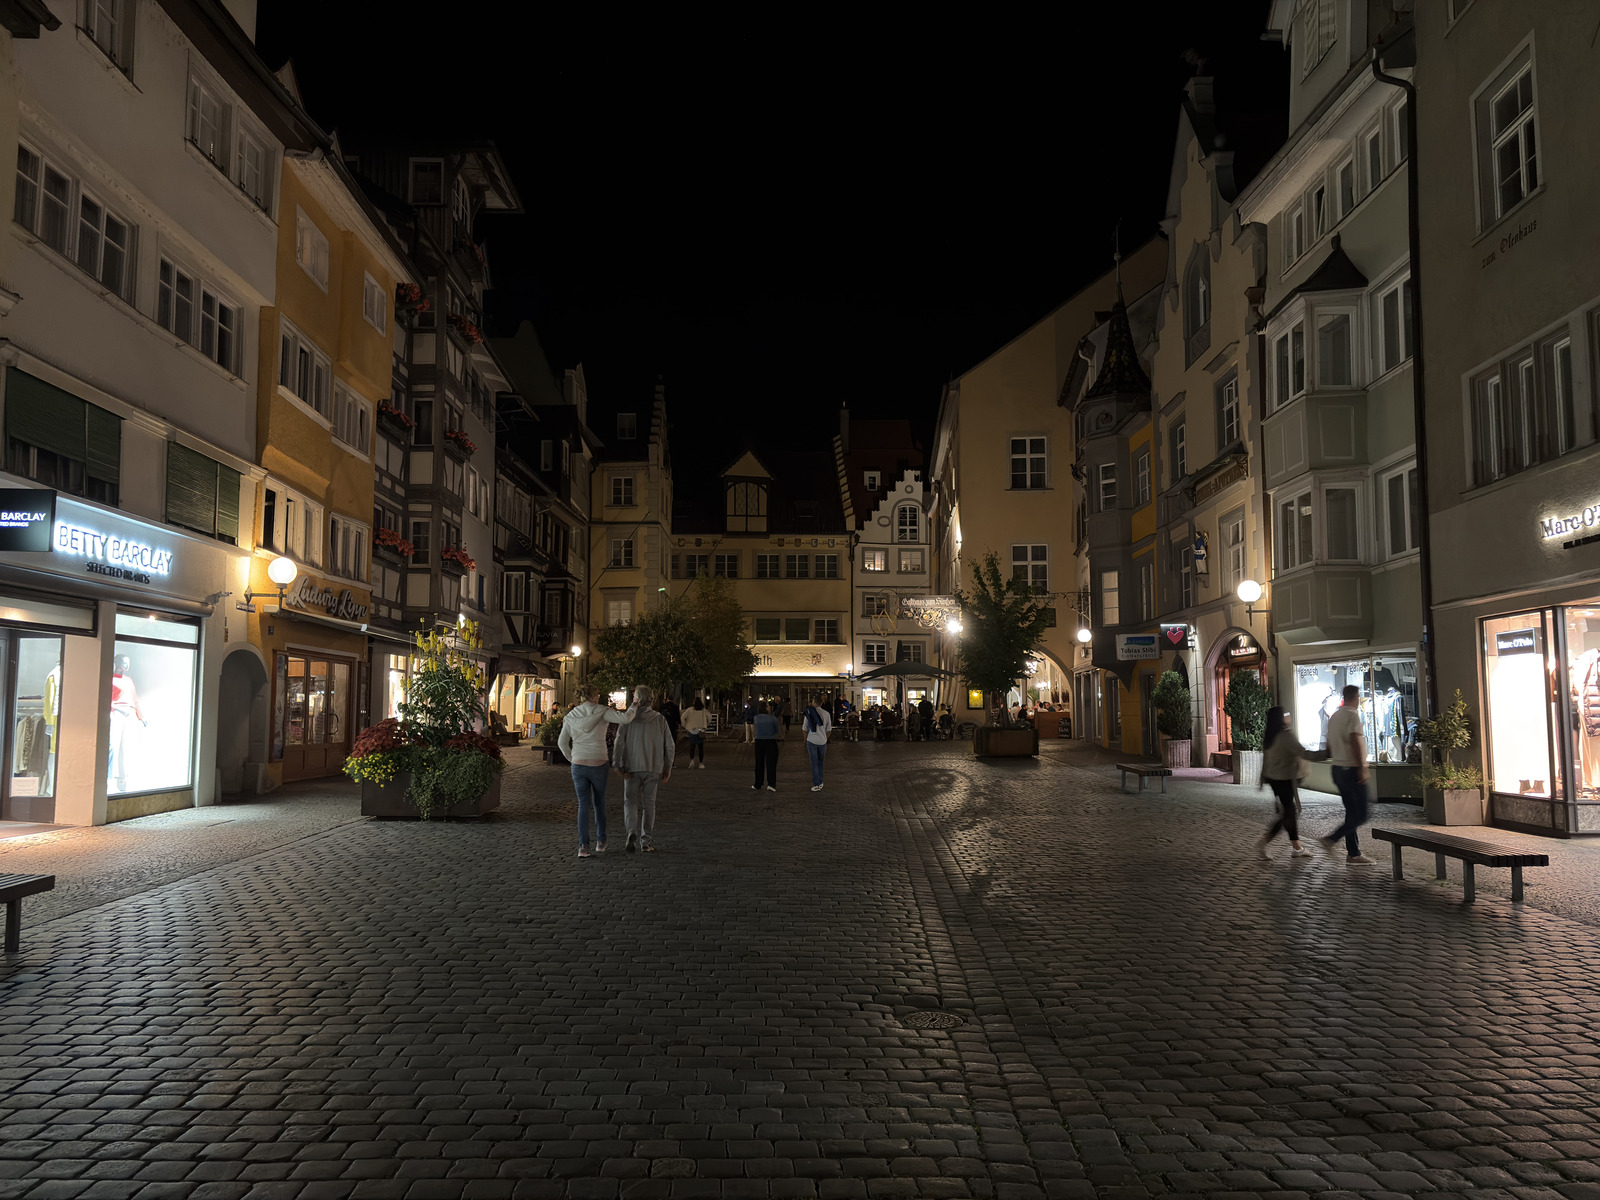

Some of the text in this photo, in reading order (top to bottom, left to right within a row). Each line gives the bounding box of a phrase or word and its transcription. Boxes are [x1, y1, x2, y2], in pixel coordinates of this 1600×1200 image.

[1, 511, 46, 521] BARCLAY
[1540, 516, 1580, 539] Marc
[59, 525, 173, 573] BETTY BARCLAY
[86, 561, 150, 585] SELECTED BRANDS
[289, 575, 338, 614] Ludwig
[1300, 666, 1318, 679] ganesh
